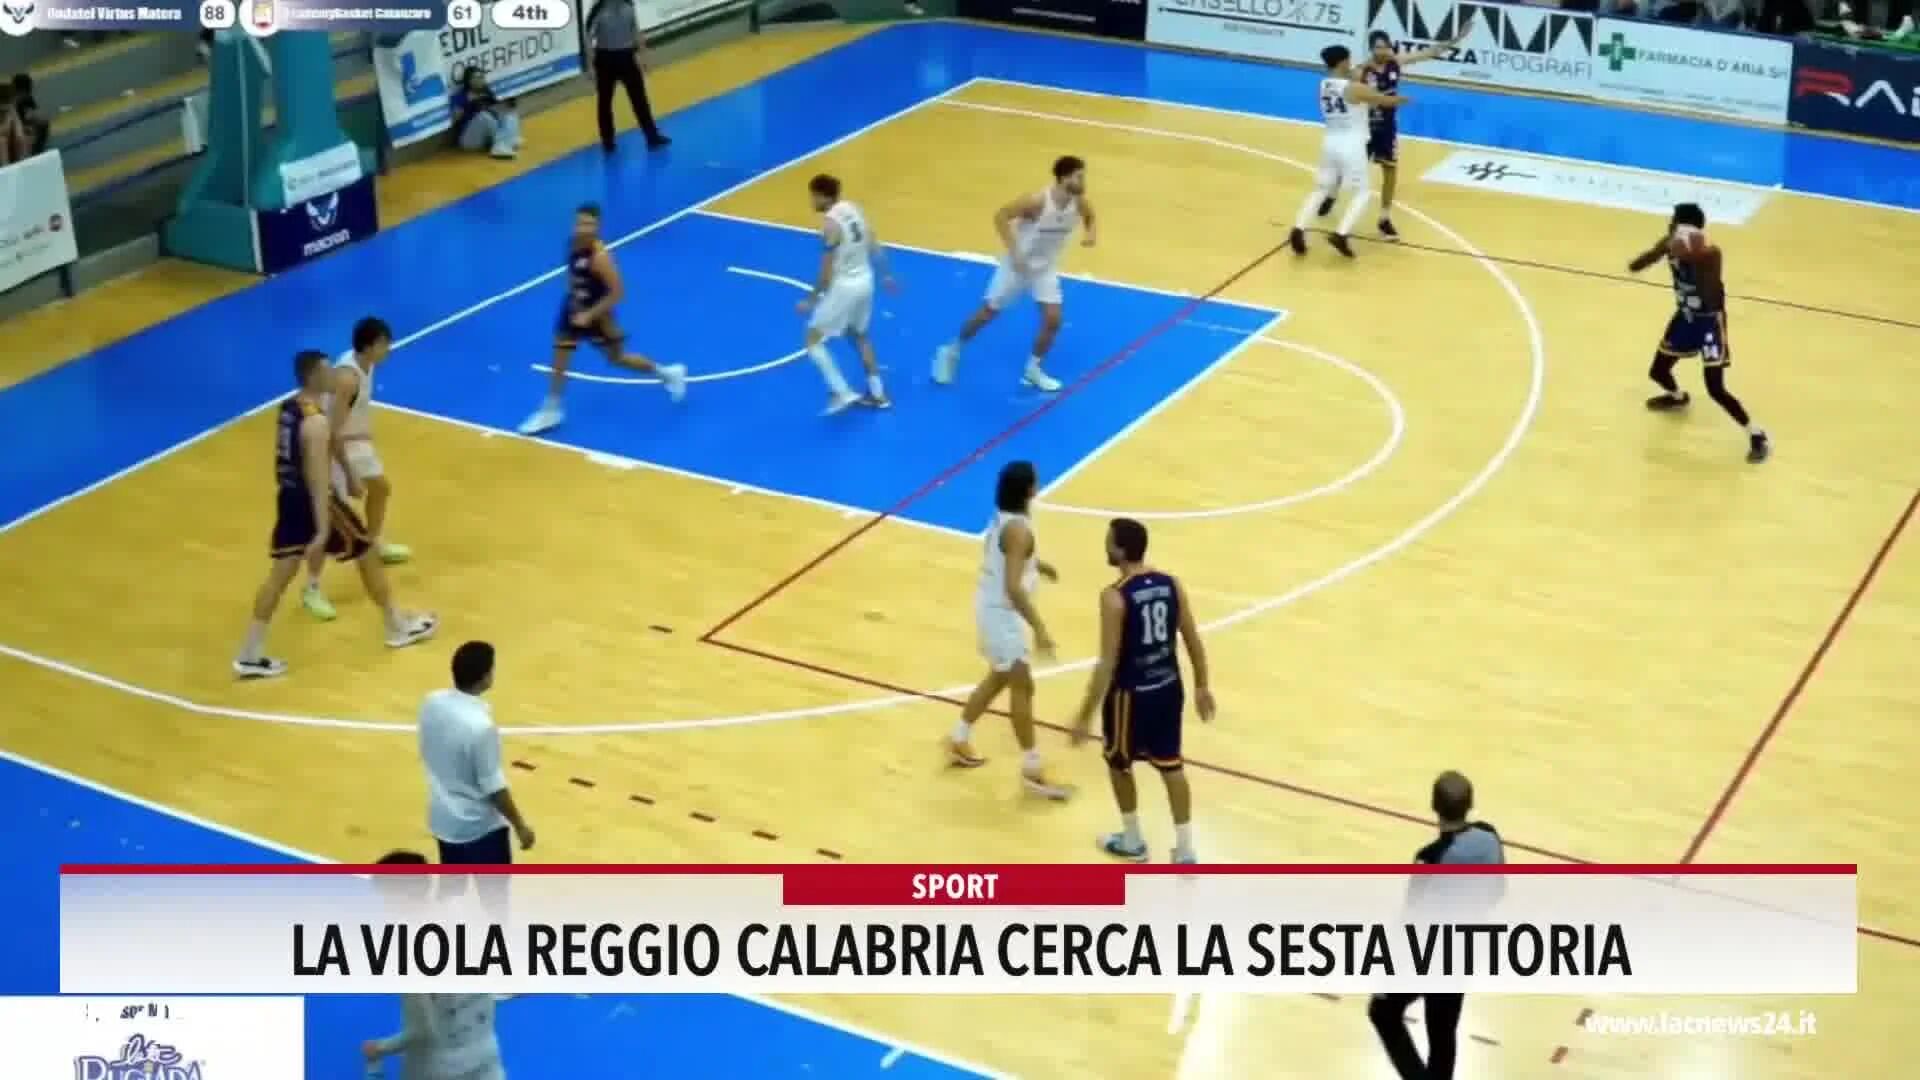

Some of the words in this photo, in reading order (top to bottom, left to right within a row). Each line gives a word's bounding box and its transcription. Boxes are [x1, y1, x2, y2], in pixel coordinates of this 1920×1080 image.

[1313, 2, 1342, 24] 75
[1638, 49, 1713, 69] FARMACIA
[1321, 95, 1348, 114] 34
[303, 228, 350, 257] macron
[1141, 600, 1169, 645] 18
